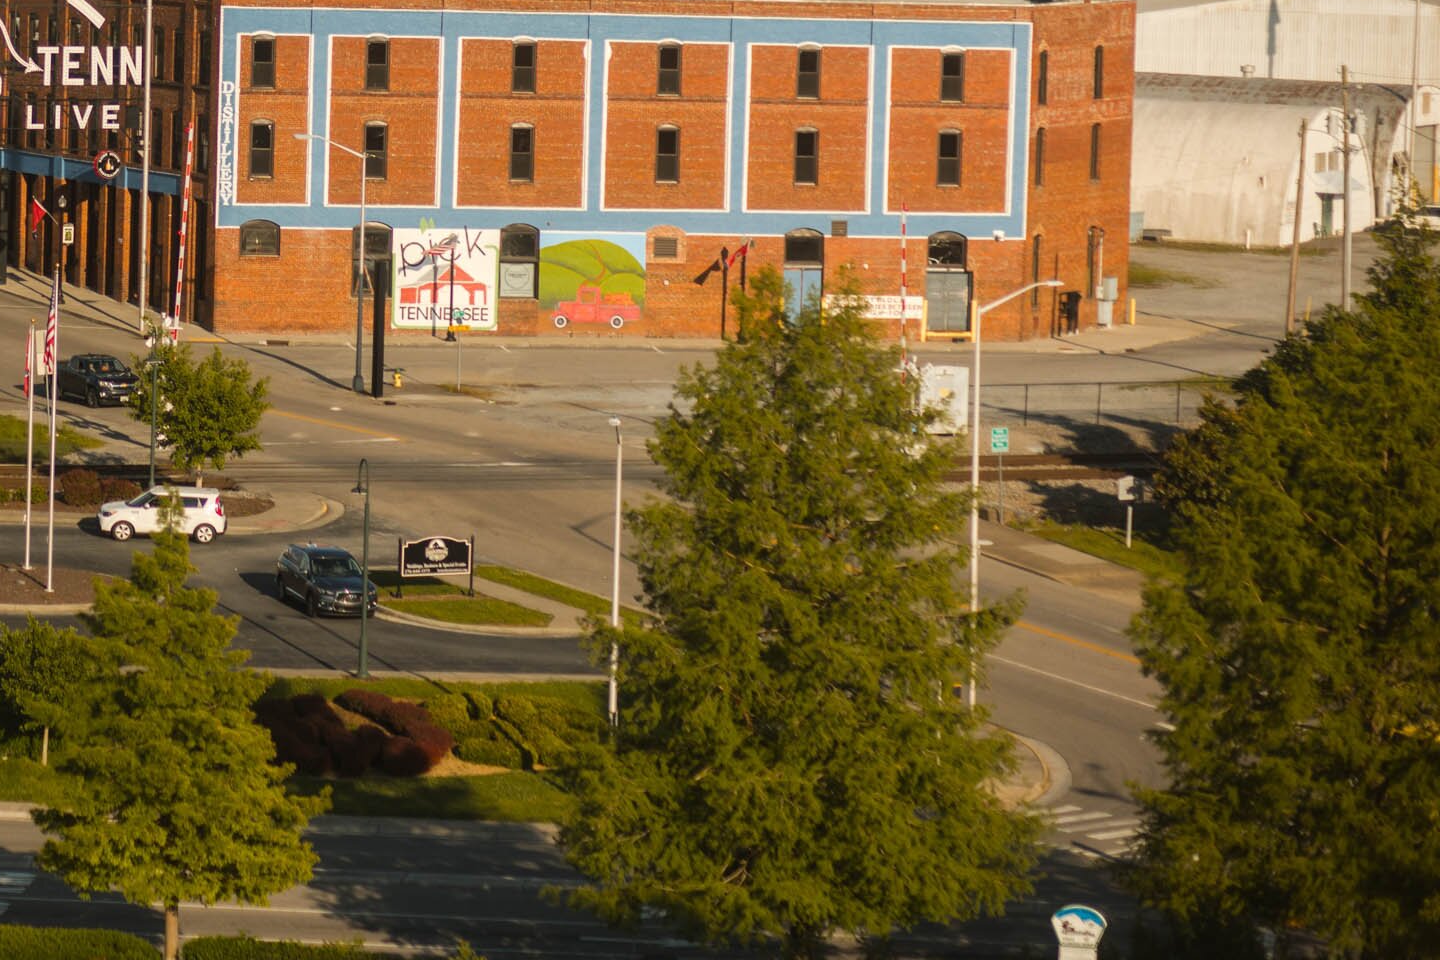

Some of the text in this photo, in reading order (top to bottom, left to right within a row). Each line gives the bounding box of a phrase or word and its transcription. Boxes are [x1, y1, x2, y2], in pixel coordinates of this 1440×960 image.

[37, 45, 142, 86] TENN
[26, 104, 121, 130] LIVE
[220, 81, 235, 206] DISTILLERY
[400, 225, 486, 277] pick
